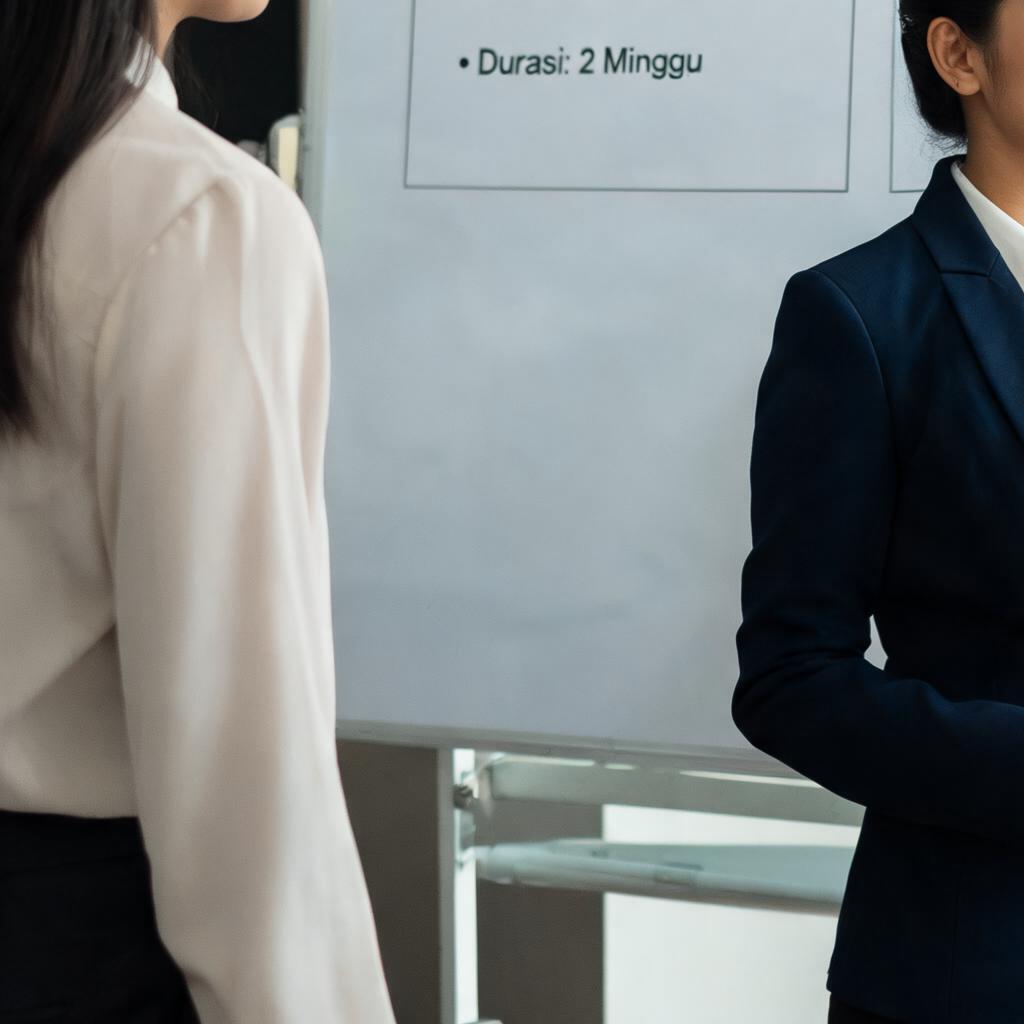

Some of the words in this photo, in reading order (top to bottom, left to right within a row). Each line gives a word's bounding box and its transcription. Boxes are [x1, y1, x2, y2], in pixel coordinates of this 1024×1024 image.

[477, 46, 571, 77] Durasi:
[578, 46, 597, 76] 2
[603, 45, 704, 81] Minggu
